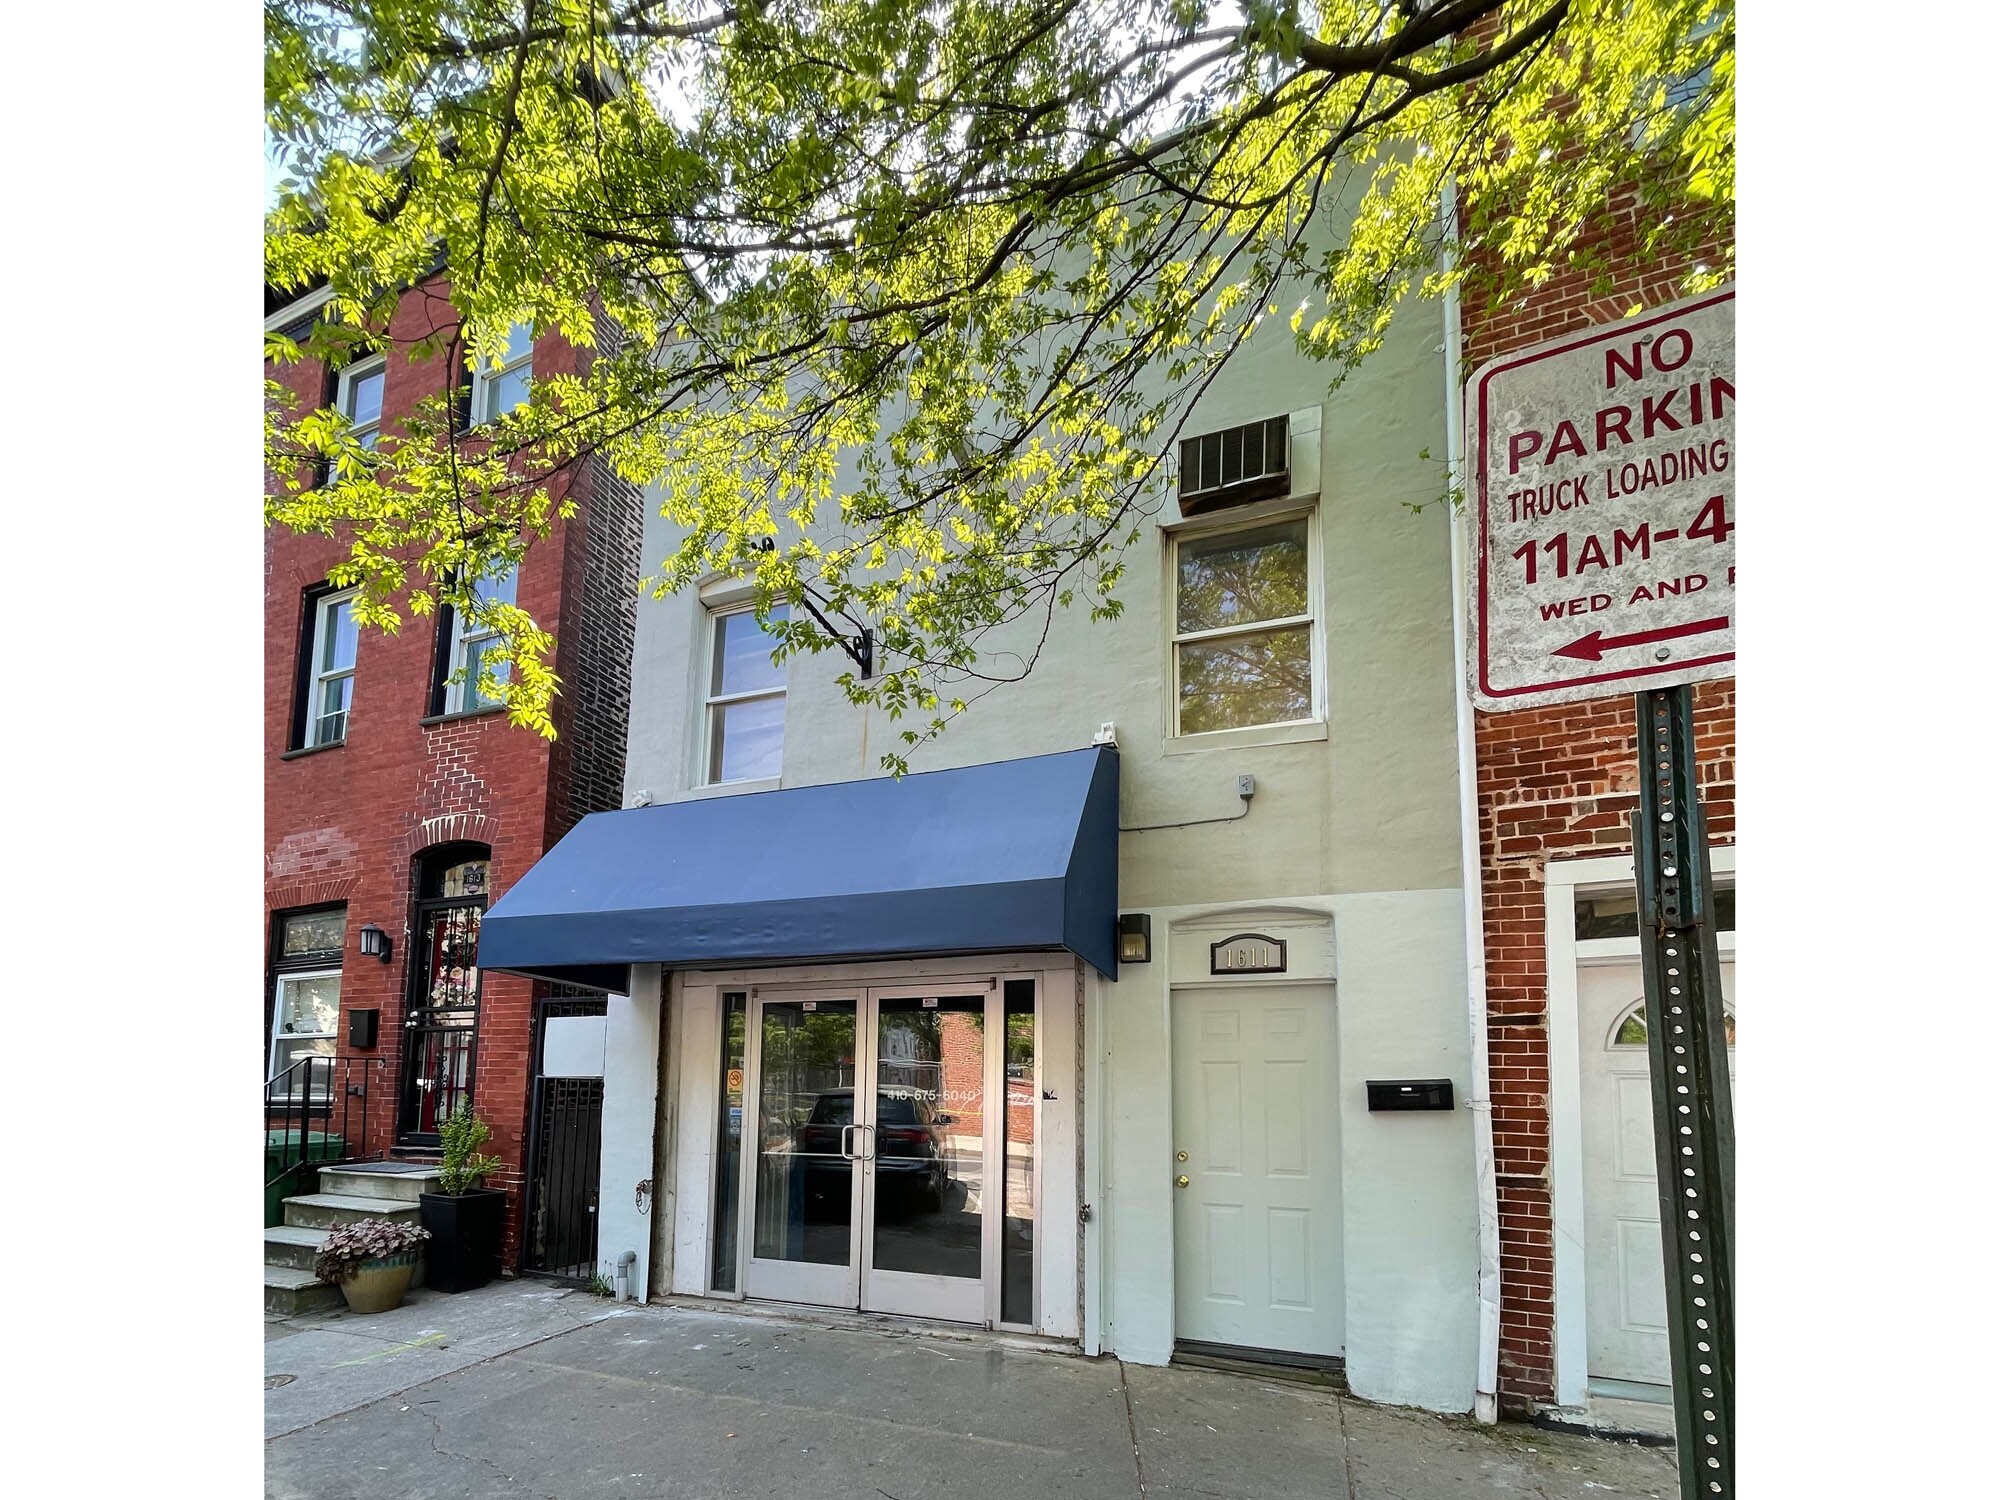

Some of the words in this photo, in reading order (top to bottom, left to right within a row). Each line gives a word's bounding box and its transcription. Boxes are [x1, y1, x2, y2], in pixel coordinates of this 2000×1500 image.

[1605, 328, 1693, 389] NO
[1508, 474, 1590, 524] TRUCK
[1607, 439, 1729, 500] LOADING
[1539, 593, 1612, 622] WED
[1628, 573, 1709, 605] AND
[1226, 946, 1269, 968] 1611
[887, 1089, 976, 1101] 410-675-6040
